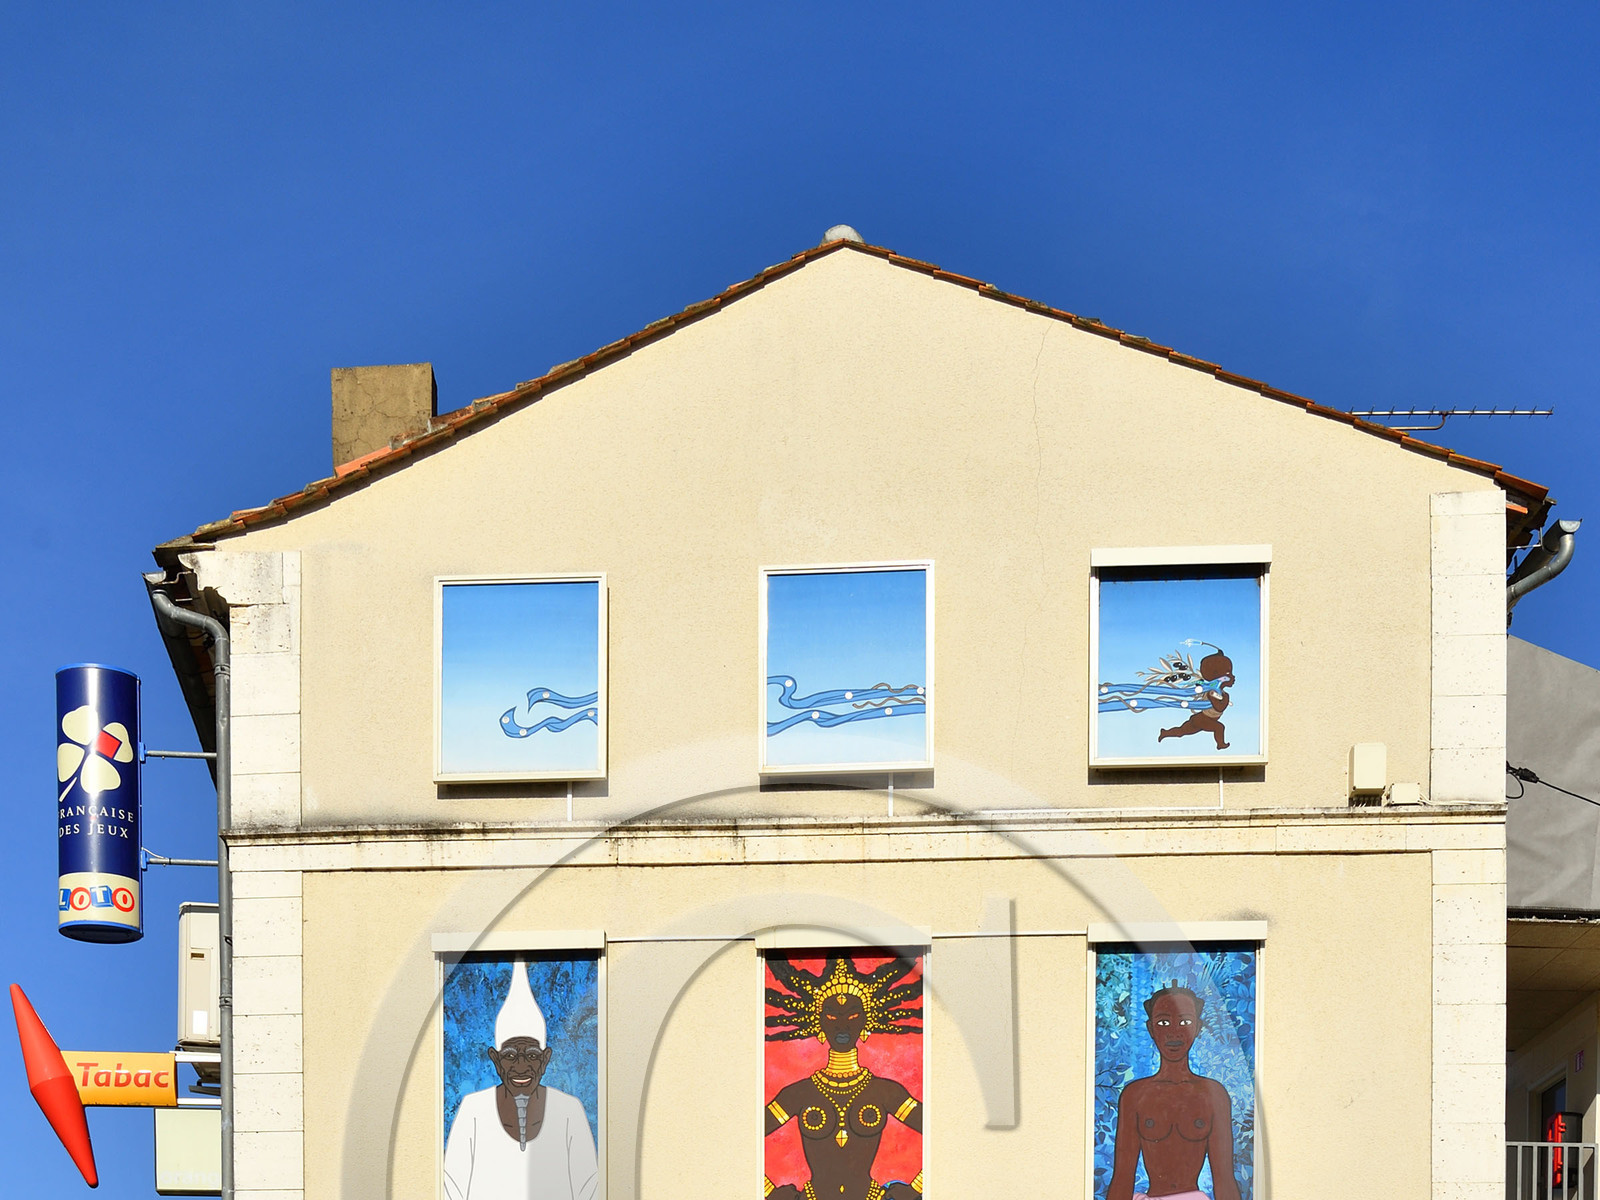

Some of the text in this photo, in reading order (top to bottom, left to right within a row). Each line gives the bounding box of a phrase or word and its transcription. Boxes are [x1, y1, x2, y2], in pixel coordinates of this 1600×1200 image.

[58, 805, 134, 823] RANÇAISE
[59, 823, 129, 839] DES JEUX
[58, 886, 135, 912] LOTO
[76, 1062, 169, 1088] Tabac
